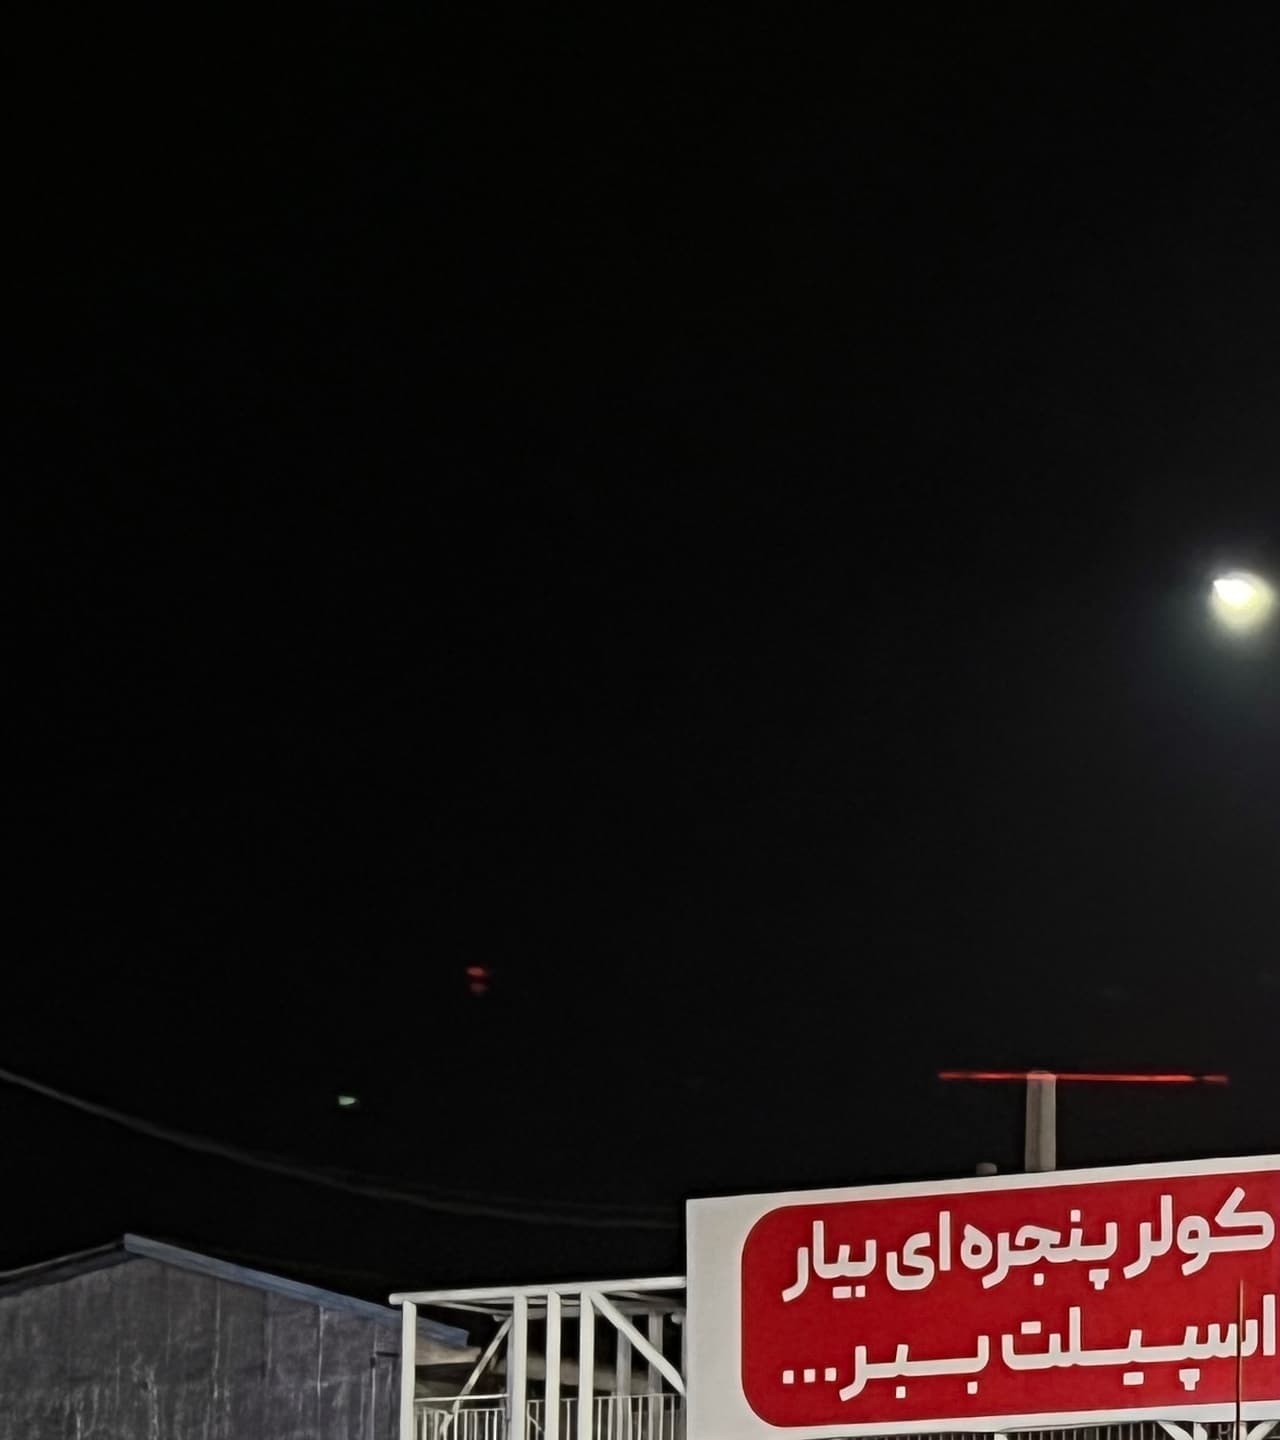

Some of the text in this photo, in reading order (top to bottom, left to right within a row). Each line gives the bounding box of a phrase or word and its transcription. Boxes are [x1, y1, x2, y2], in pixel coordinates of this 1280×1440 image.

[782, 1220, 877, 1302] بیار
[1124, 1187, 1275, 1279] کولر
[1001, 1294, 1277, 1391] اسپیلت
